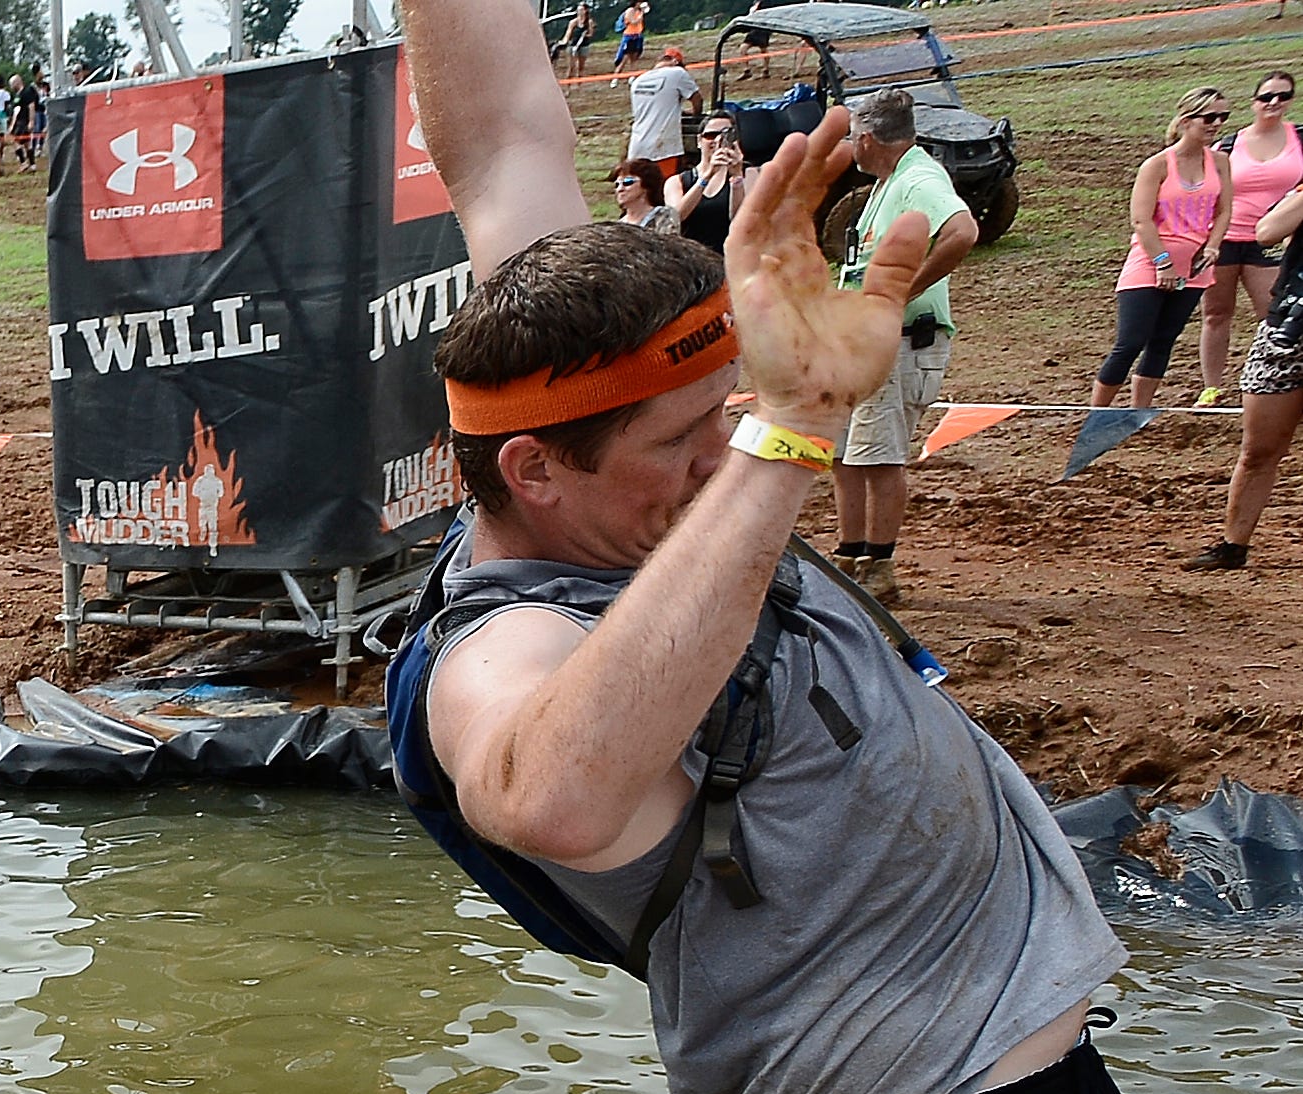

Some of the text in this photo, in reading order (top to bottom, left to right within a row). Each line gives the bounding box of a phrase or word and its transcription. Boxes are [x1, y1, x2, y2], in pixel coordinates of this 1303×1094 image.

[90, 197, 214, 220] UNDER ARMOUR
[48, 296, 280, 380] I WILL.
[664, 316, 726, 365] TOUGH
[382, 441, 453, 505] TOUGH
[75, 478, 187, 520] TOUGH
[381, 481, 454, 530] MUDDER
[75, 517, 190, 548] MUDDER
